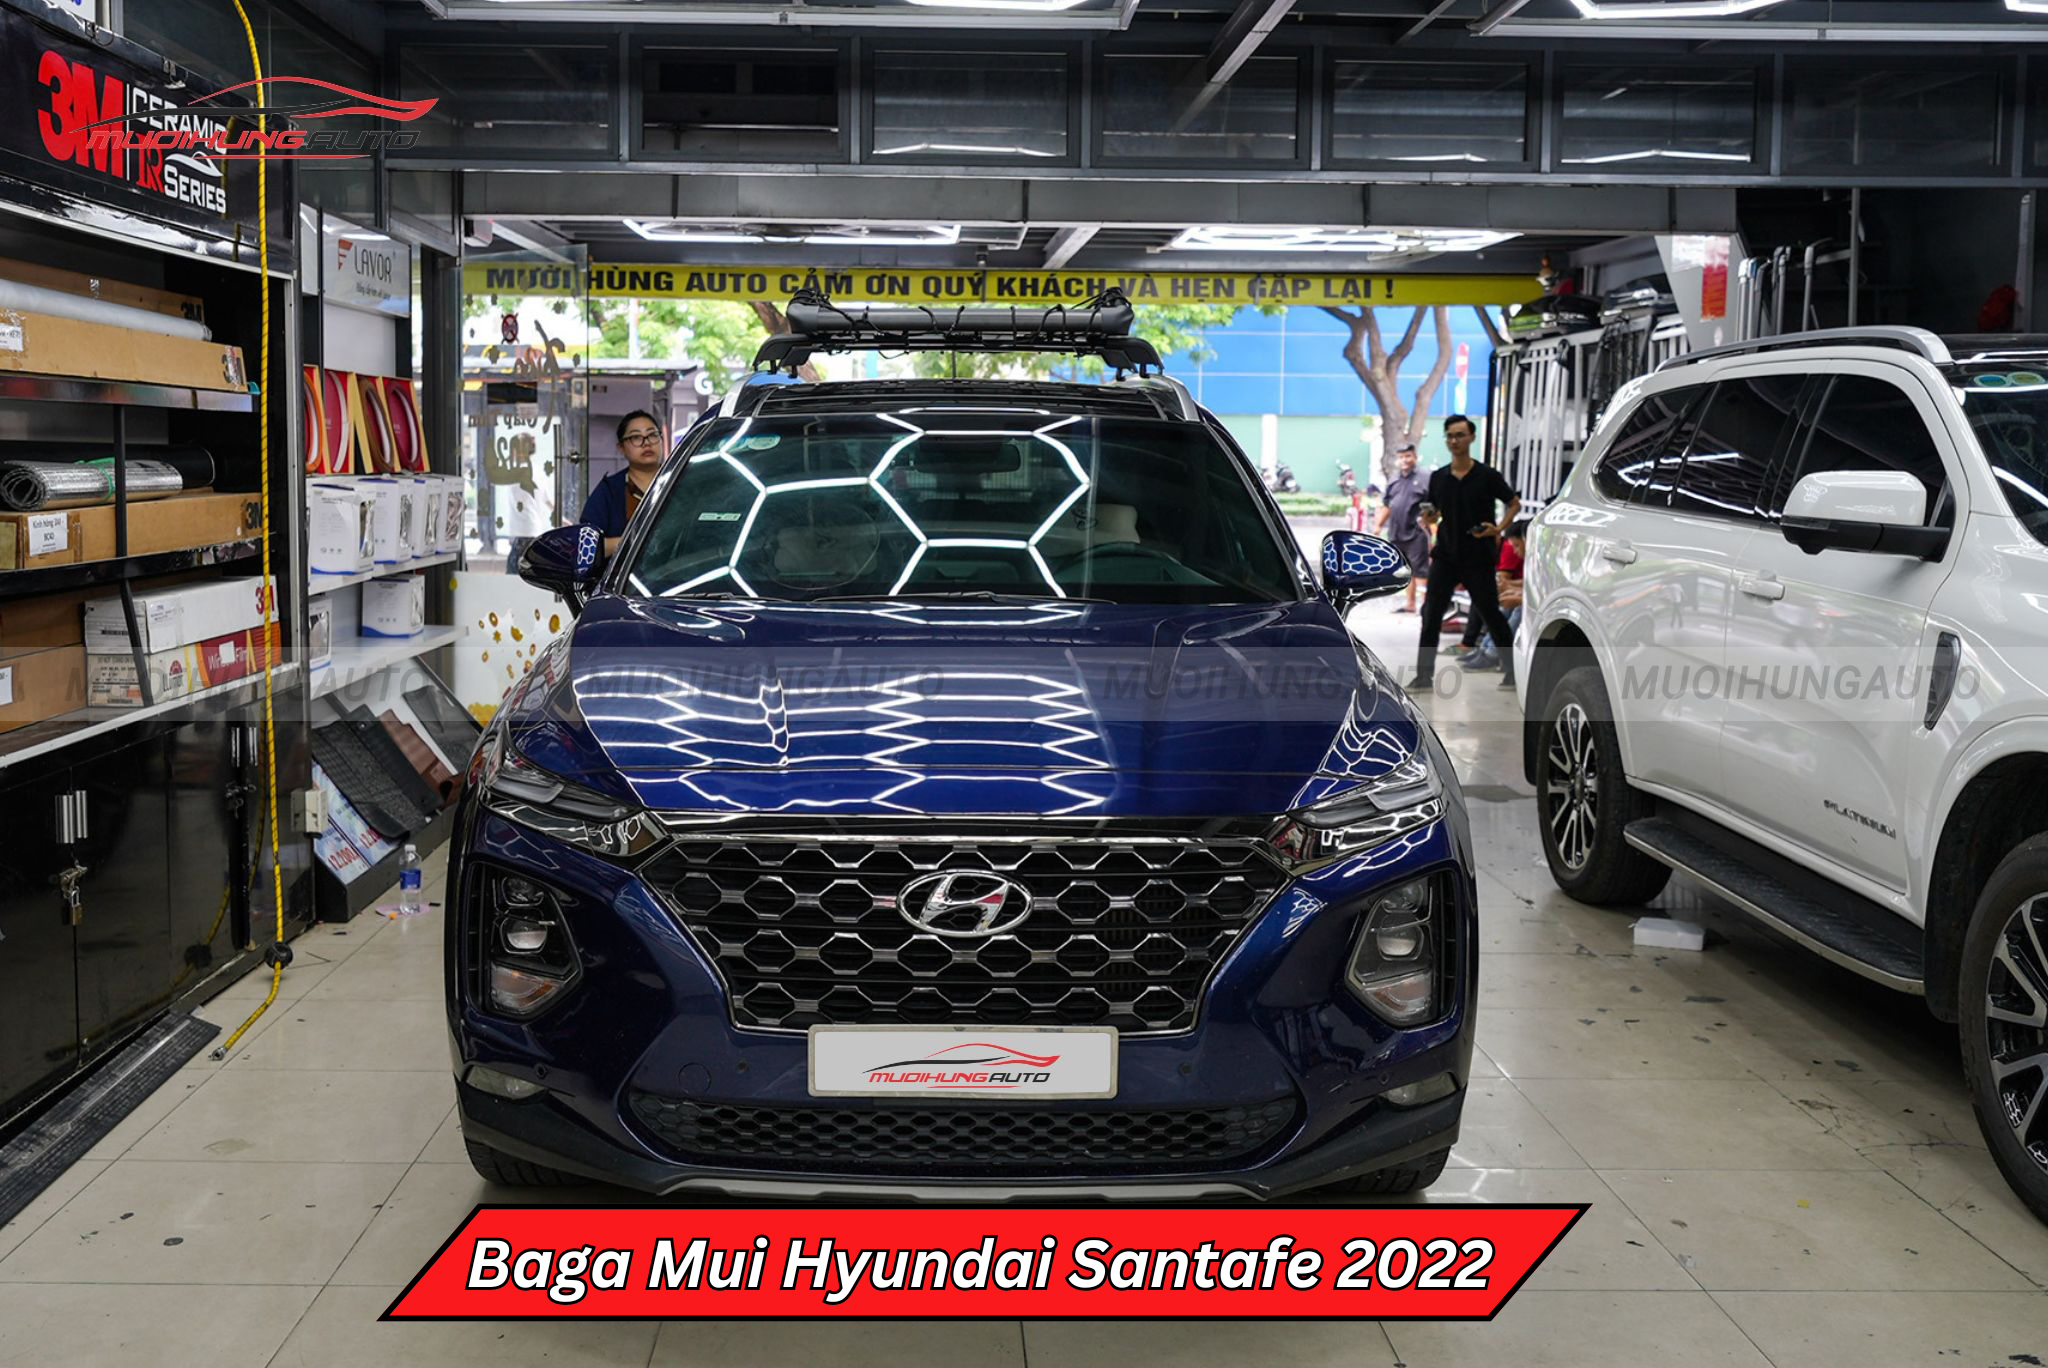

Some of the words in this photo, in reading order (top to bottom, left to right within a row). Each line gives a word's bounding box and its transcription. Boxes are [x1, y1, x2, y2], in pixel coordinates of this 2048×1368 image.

[37, 50, 125, 178] 3M
[132, 87, 228, 155] CERAMIC
[588, 266, 674, 292] HÙNG
[685, 271, 767, 293] AUTO
[865, 272, 910, 296] ƠN
[922, 272, 985, 298] QUÝ
[996, 271, 1105, 298] KHÁCH
